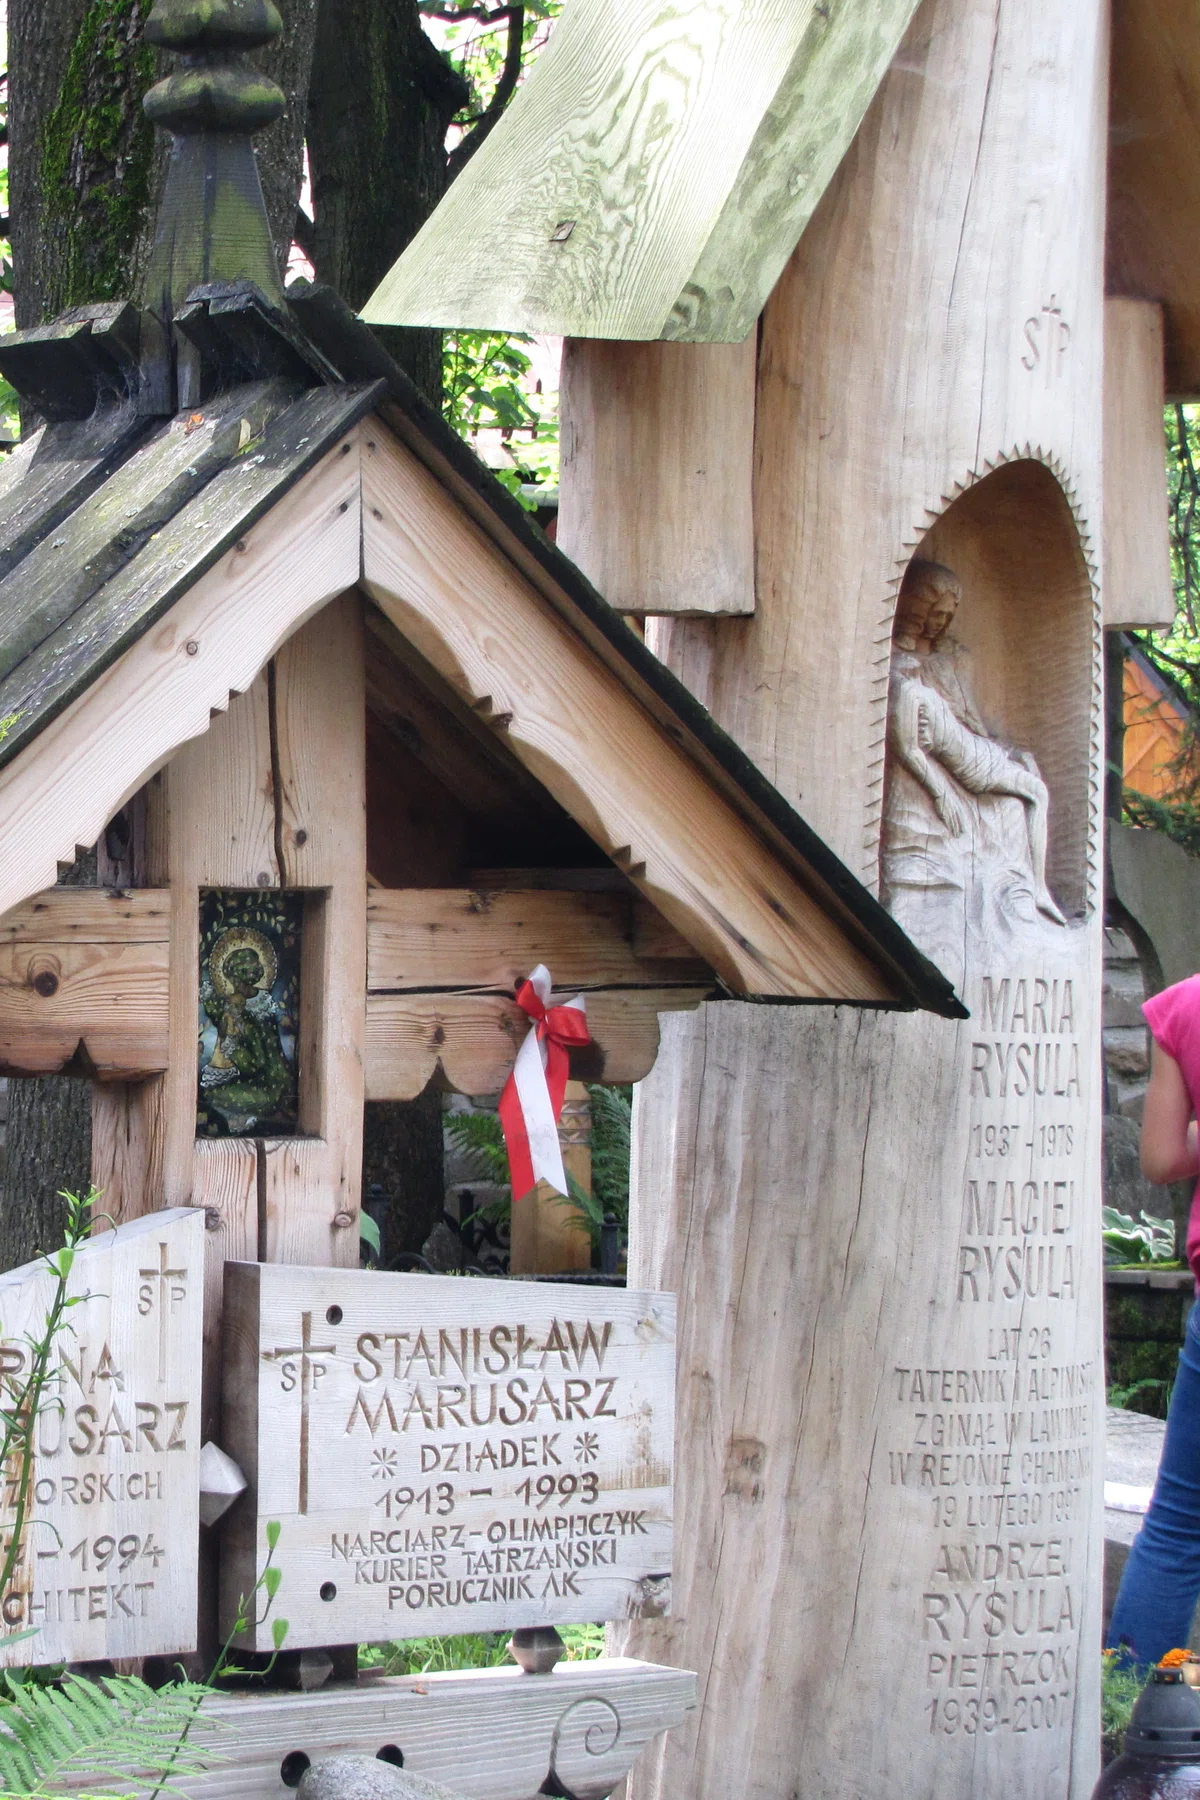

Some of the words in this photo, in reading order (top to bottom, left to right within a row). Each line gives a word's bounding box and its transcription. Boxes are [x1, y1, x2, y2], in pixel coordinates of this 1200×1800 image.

[980, 976, 1075, 1034] MARIA
[968, 1042, 1081, 1099] RYSULA
[956, 1244, 1076, 1302] RYSULA
[136, 1284, 154, 1316] S
[170, 1286, 187, 1315] P
[352, 1316, 614, 1383] STANISŁAW
[987, 1327, 1022, 1361] LAT
[280, 1362, 297, 1392] S
[312, 1363, 328, 1390] P
[894, 1366, 1007, 1403] TATERNIK
[343, 1375, 620, 1440] MARUSARZ
[1004, 1411, 1023, 1444] W
[420, 1432, 563, 1474] DZIADEK
[889, 1451, 913, 1487] W
[920, 1452, 1013, 1488] REJONIE
[374, 1482, 456, 1522] 1913
[514, 1471, 600, 1512] 1993
[931, 1495, 959, 1529] 19
[967, 1492, 1043, 1528] LUTEGO
[68, 1533, 166, 1574] 1994
[354, 1553, 450, 1586] KURIER
[461, 1537, 618, 1578] TATRZAŃSKI
[930, 1537, 1073, 1583] ANDRZEJ
[387, 1572, 536, 1611] PORUCZNIK
[920, 1585, 1075, 1642] RYSULA
[926, 1645, 1072, 1691] PIETRZOK
